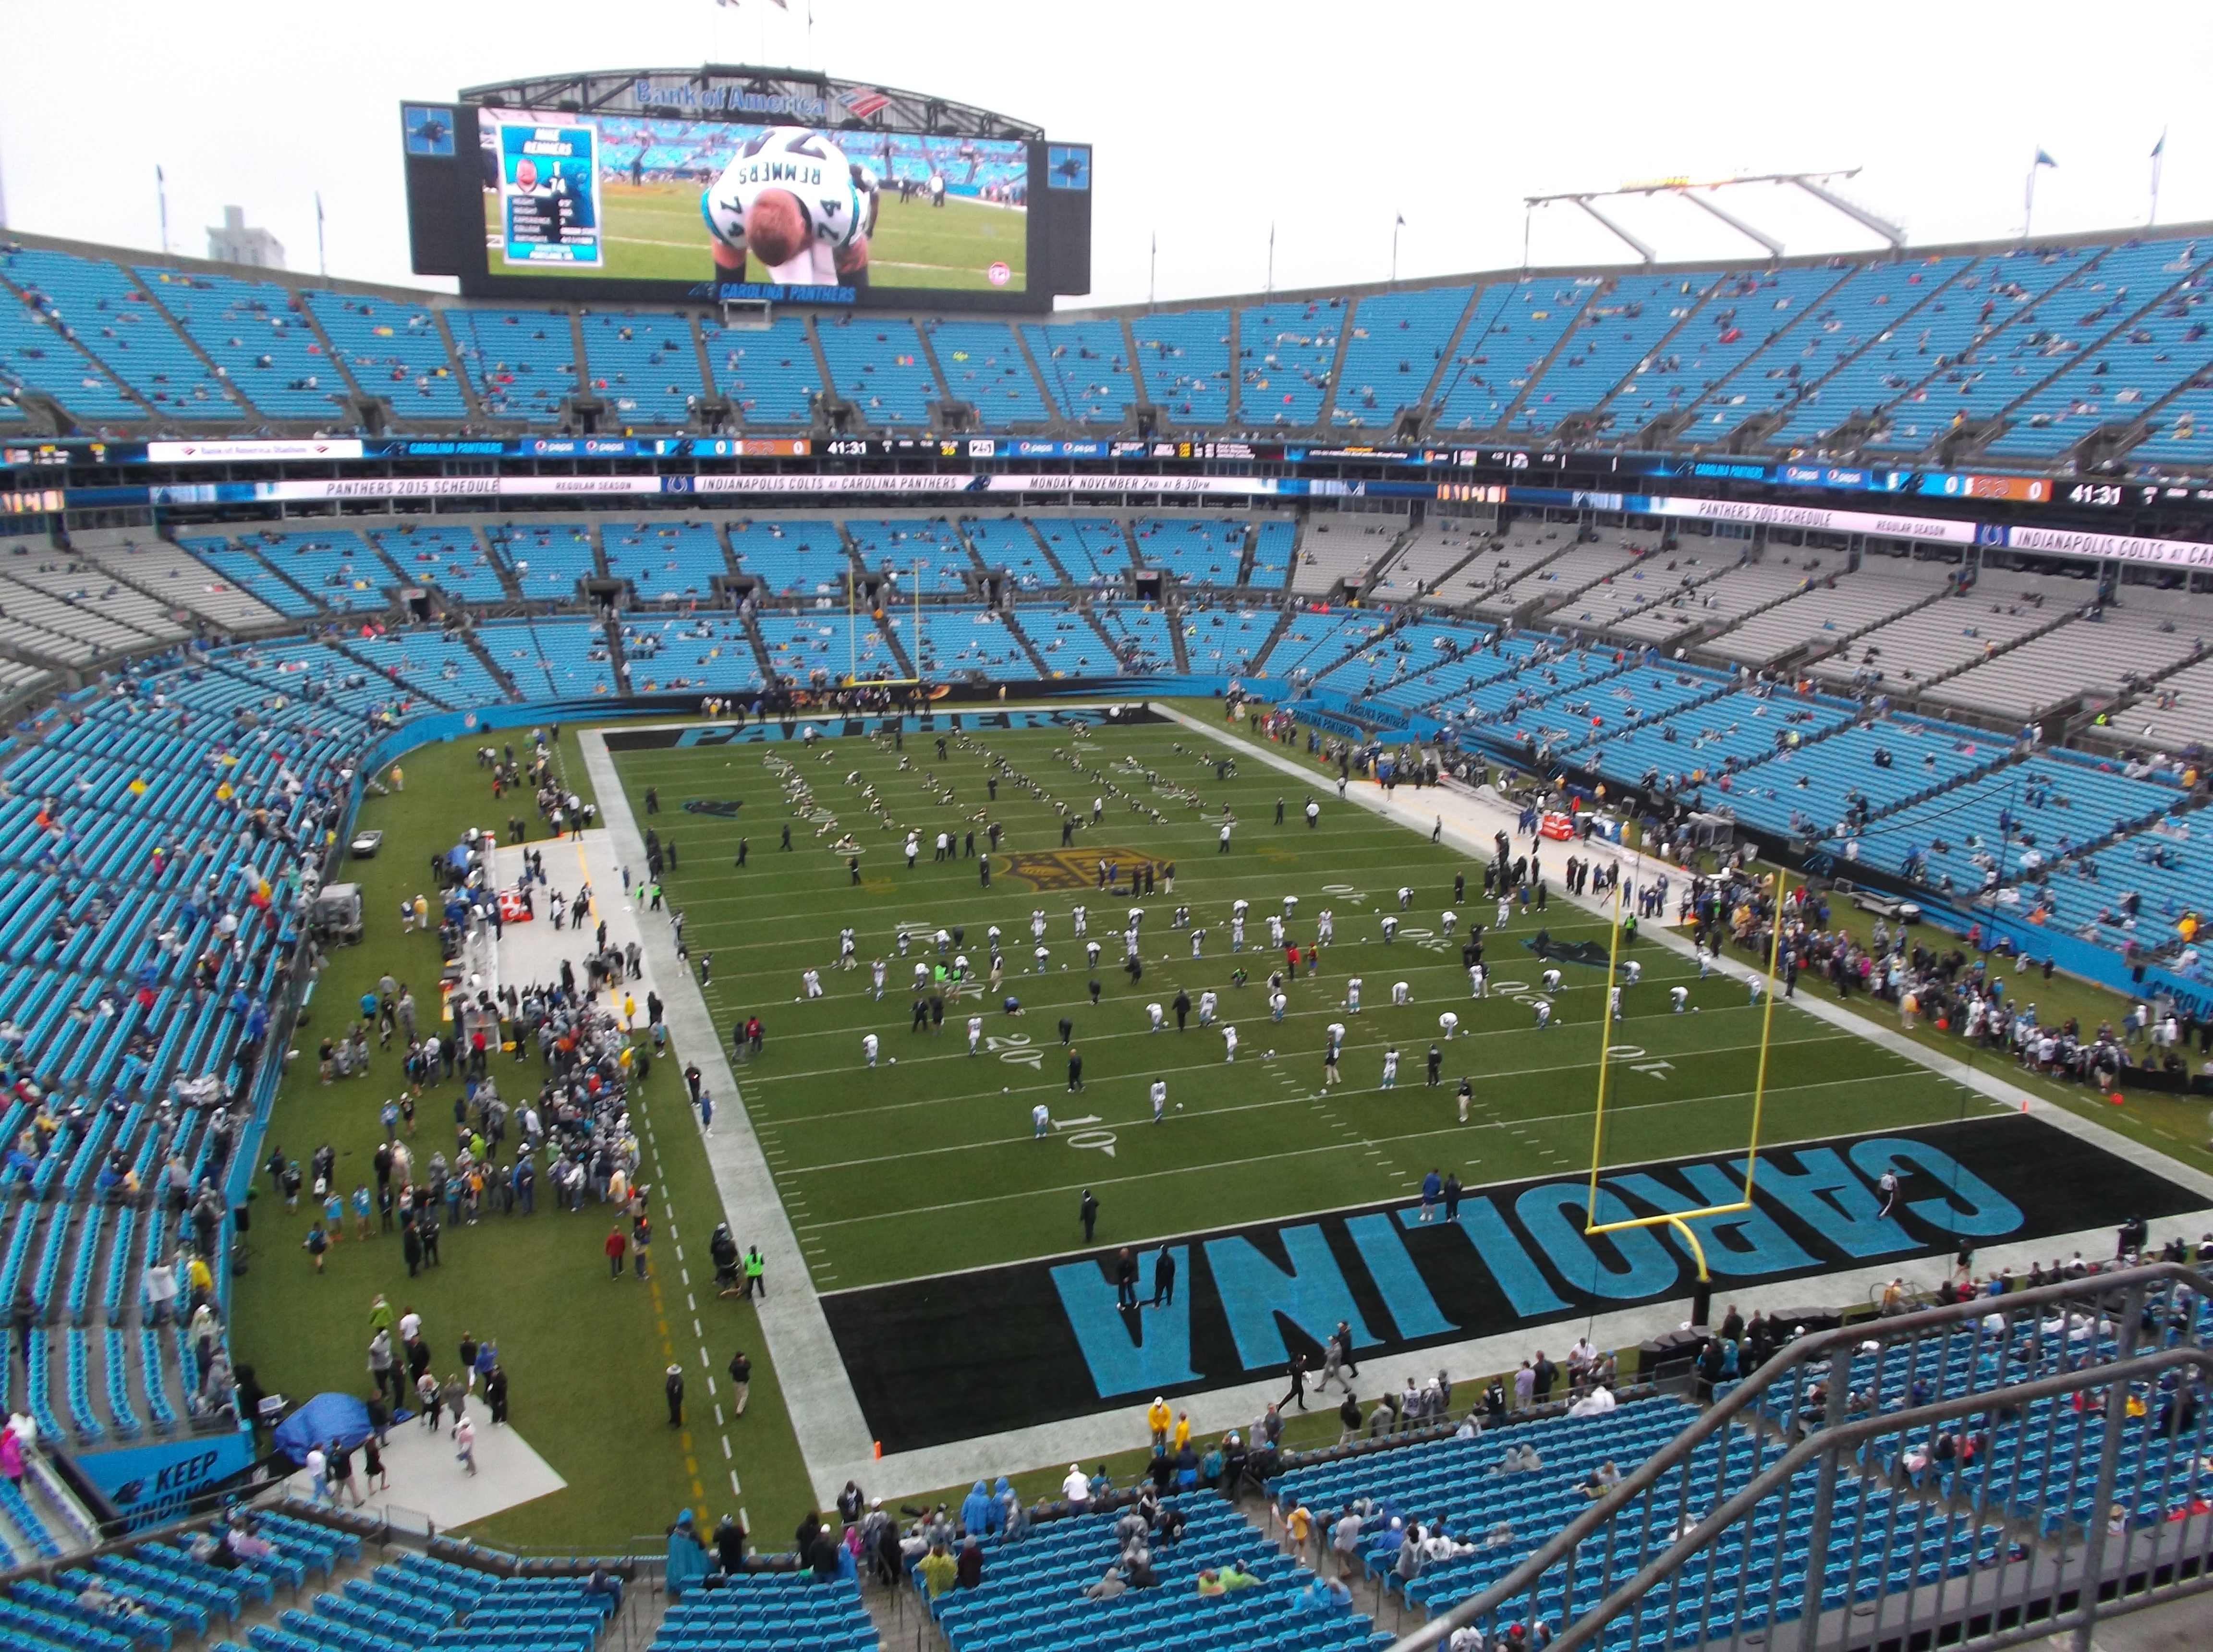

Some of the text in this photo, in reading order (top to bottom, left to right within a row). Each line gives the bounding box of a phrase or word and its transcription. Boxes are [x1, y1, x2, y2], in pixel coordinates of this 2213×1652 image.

[636, 80, 826, 115] Bank of America
[739, 161, 821, 185] REMMERS
[715, 440, 726, 454] 0
[793, 440, 804, 455] 0
[827, 441, 866, 454] 41:31
[327, 479, 500, 496] PANTHERS 2015 SCHEDULE
[702, 477, 784, 491] INDIANAPOLIS
[789, 477, 823, 490] COLTS
[842, 477, 896, 490] CAROLINA
[900, 476, 957, 489] PANTHERS
[1079, 477, 1138, 489] NOVEMBER
[1945, 475, 1958, 495] 0
[2028, 482, 2042, 499] 0
[1698, 502, 1834, 527] PANTHERS 2015 SCHEDULE
[2018, 530, 2114, 554] INDIANAPOLIS
[2119, 538, 2165, 559] COLTS
[675, 709, 1107, 748] PANTHERS
[985, 1033, 1045, 1063] 20
[1050, 1114, 1118, 1148] 10
[1049, 1138, 2025, 1399] CAROLINA
[154, 1449, 219, 1494] KEEP
